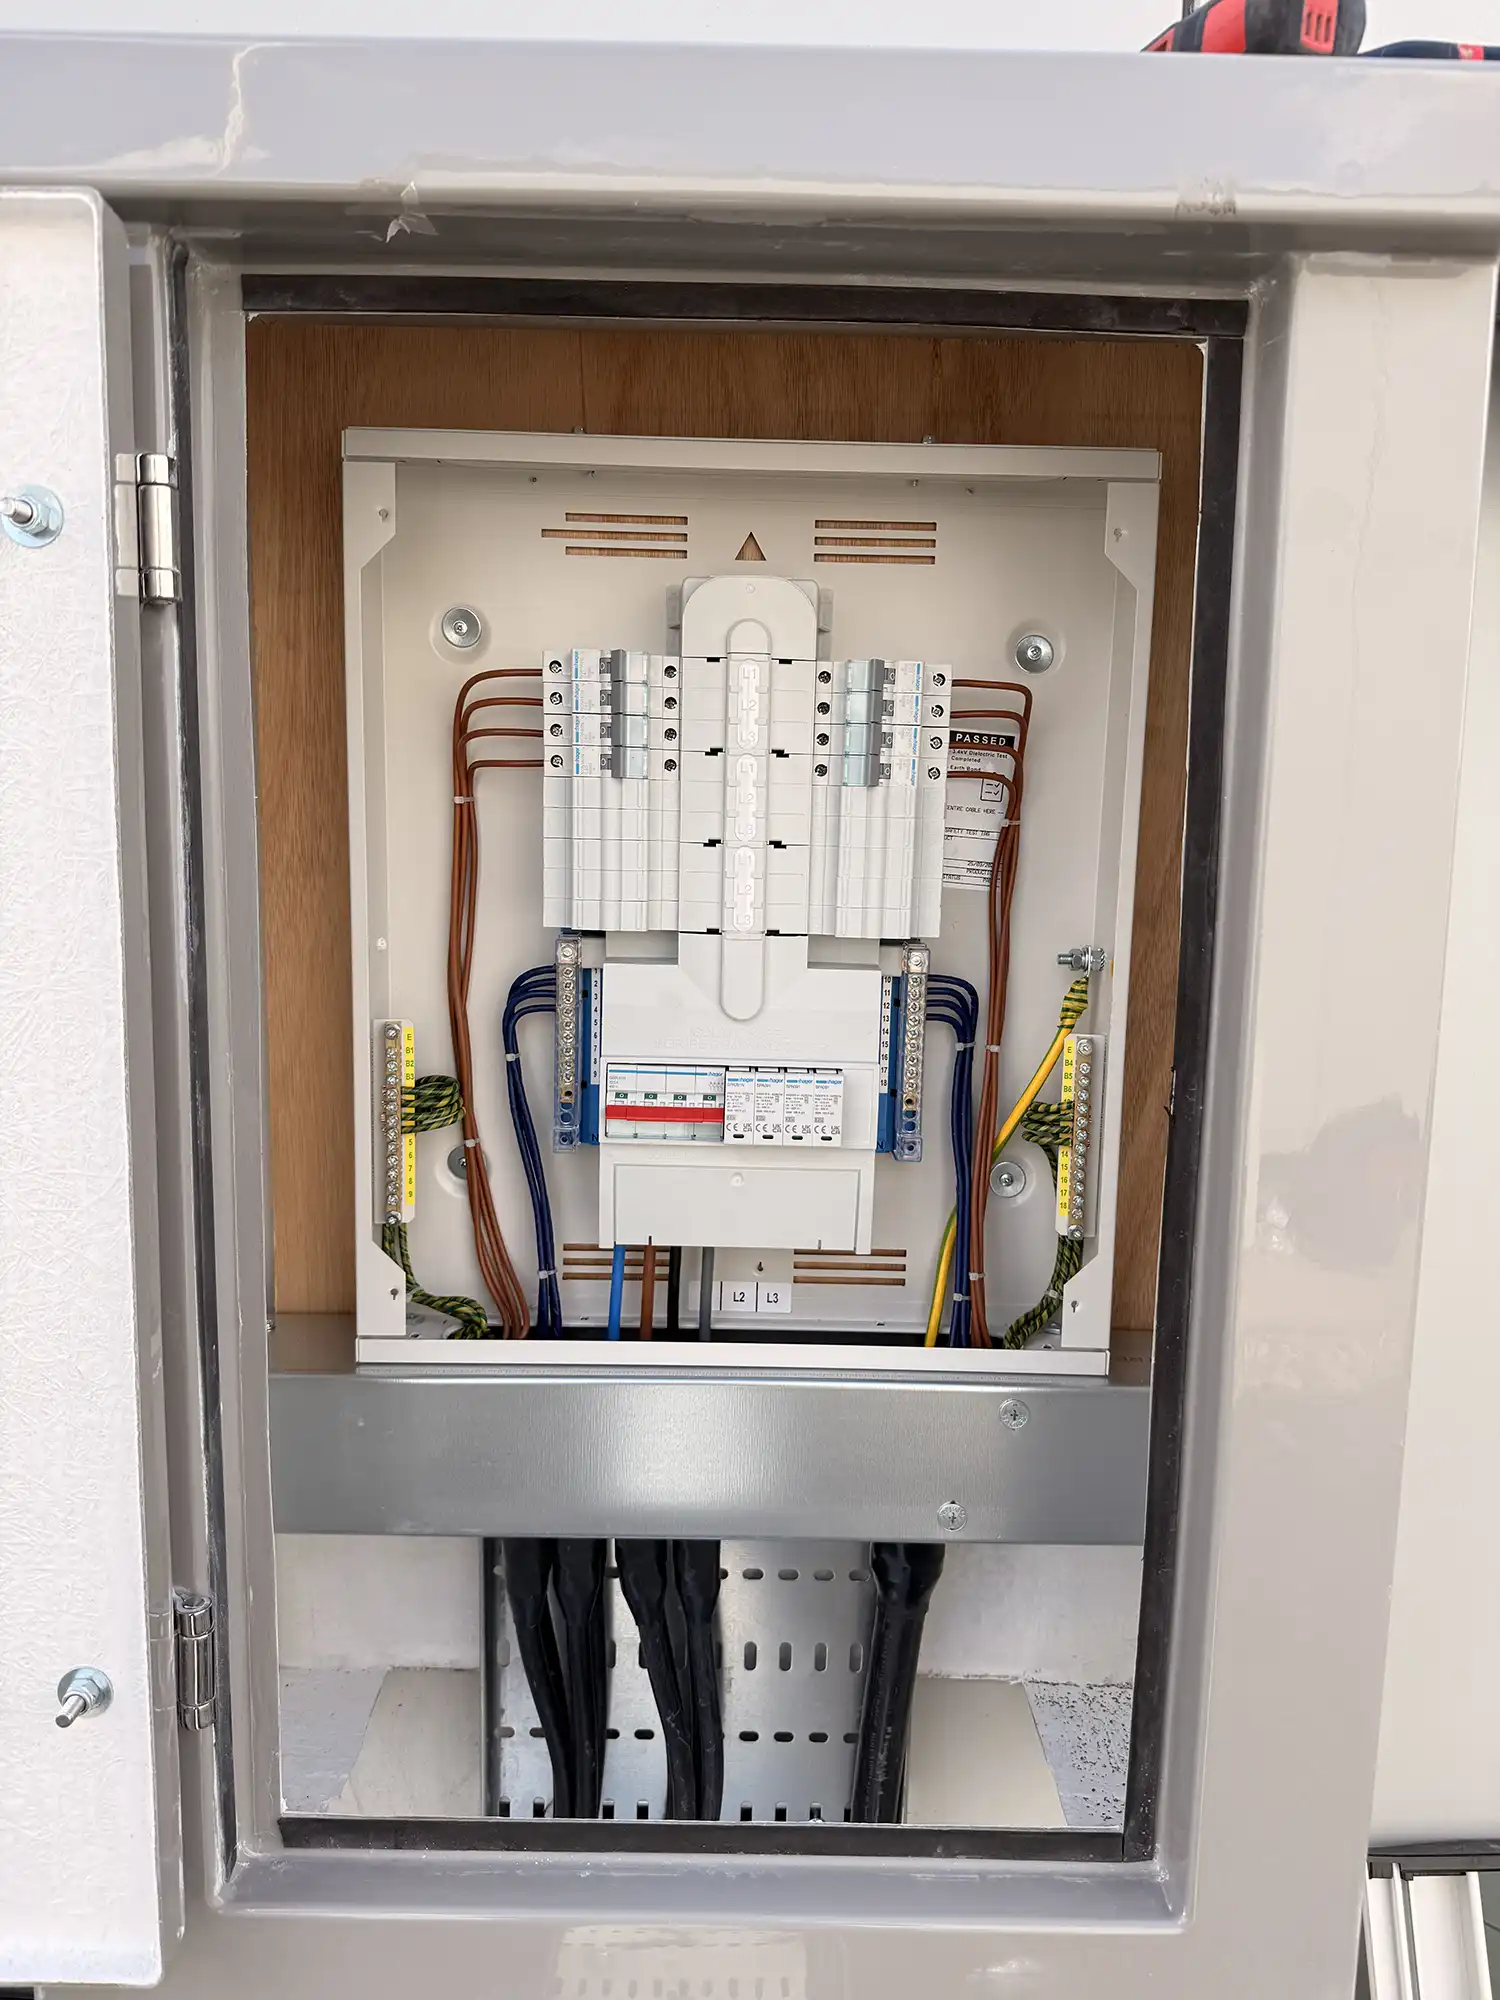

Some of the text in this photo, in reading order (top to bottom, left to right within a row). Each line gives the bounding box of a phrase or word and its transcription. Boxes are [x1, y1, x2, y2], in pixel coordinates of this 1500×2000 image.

[742, 668, 756, 679] L1
[741, 700, 757, 711] L2
[740, 731, 756, 742] L3
[956, 734, 1006, 746] PASSED
[740, 762, 754, 773] L1
[738, 794, 754, 804] L2
[737, 885, 751, 895] L2
[726, 1123, 738, 1131] CE
[756, 1123, 768, 1132] CE
[785, 1124, 797, 1133] CE
[814, 1125, 826, 1134] CE
[876, 1141, 883, 1150] N
[733, 1292, 779, 1303] L2 L3
